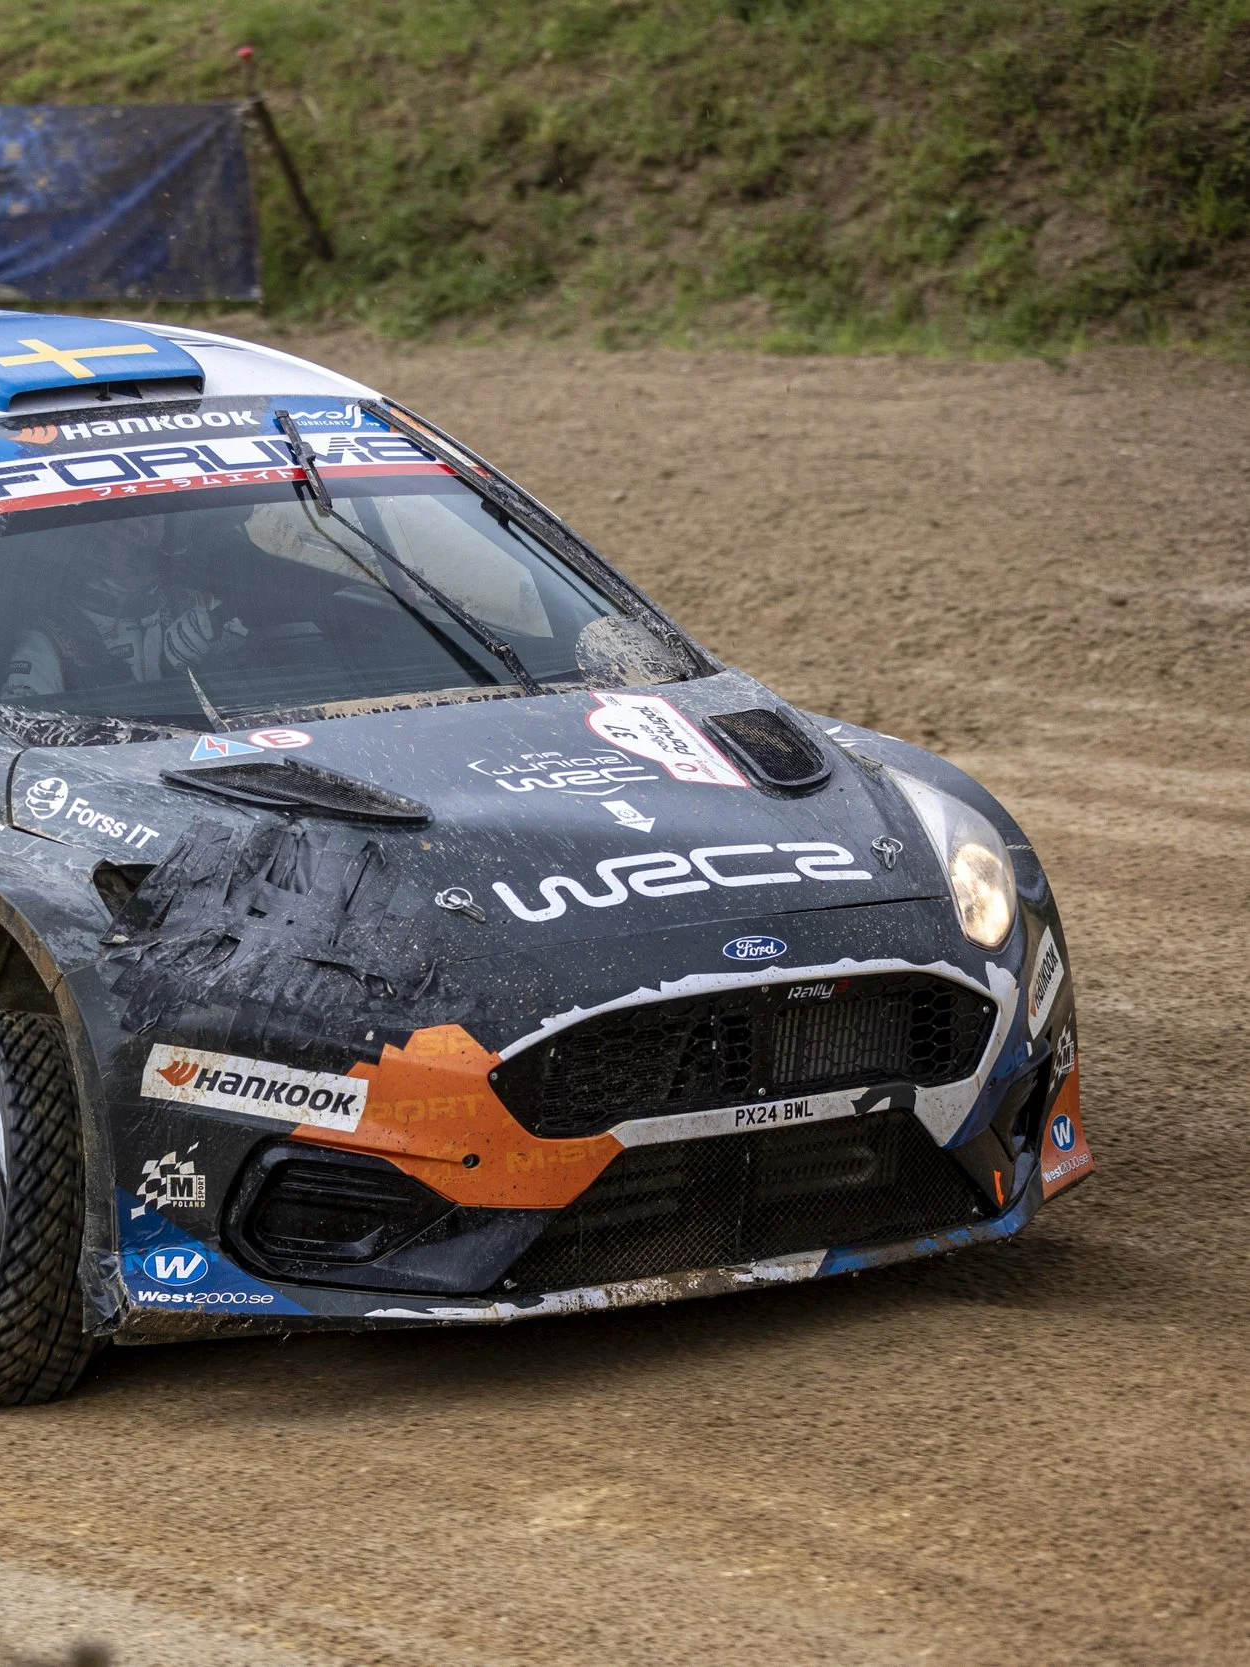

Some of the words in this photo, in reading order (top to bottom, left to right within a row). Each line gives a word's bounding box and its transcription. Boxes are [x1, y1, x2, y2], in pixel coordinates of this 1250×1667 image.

[92, 468, 295, 496] フォーラムエイト
[603, 724, 639, 741] 37
[492, 756, 625, 775] JUNIOR
[521, 751, 563, 761] FIA
[496, 766, 659, 792] WRC
[65, 797, 126, 838] Forss
[124, 823, 159, 849] IT
[492, 842, 872, 922] WRC2
[735, 936, 777, 958] Ford
[735, 1102, 778, 1128] PX24
[784, 1098, 814, 1121] BWL
[1053, 1118, 1071, 1148] W
[170, 1177, 193, 1198] M
[197, 1176, 205, 1199] SPORT
[173, 1200, 206, 1208] POLAND
[155, 1254, 204, 1279] W
[138, 1290, 274, 1304] West2000.se
